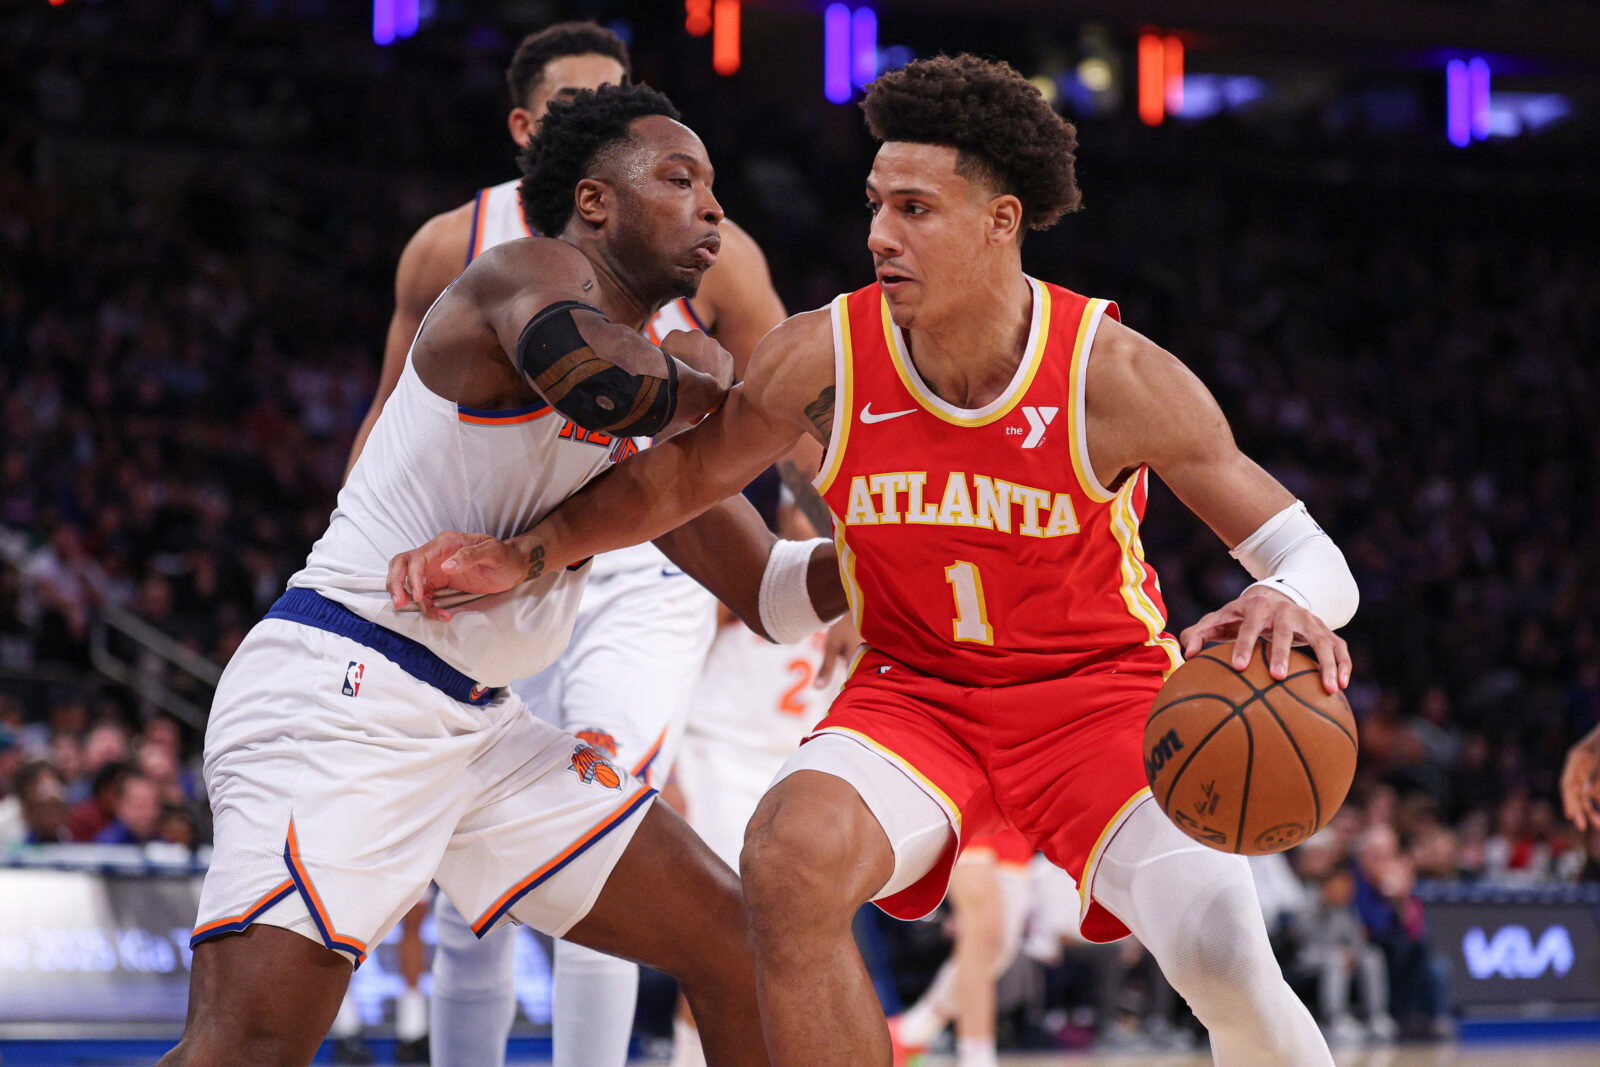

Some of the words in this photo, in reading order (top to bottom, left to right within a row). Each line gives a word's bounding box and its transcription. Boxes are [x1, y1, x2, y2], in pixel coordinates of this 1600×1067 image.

[1005, 426, 1023, 435] the
[845, 471, 1080, 538] ATLANTA
[944, 560, 994, 646] 1
